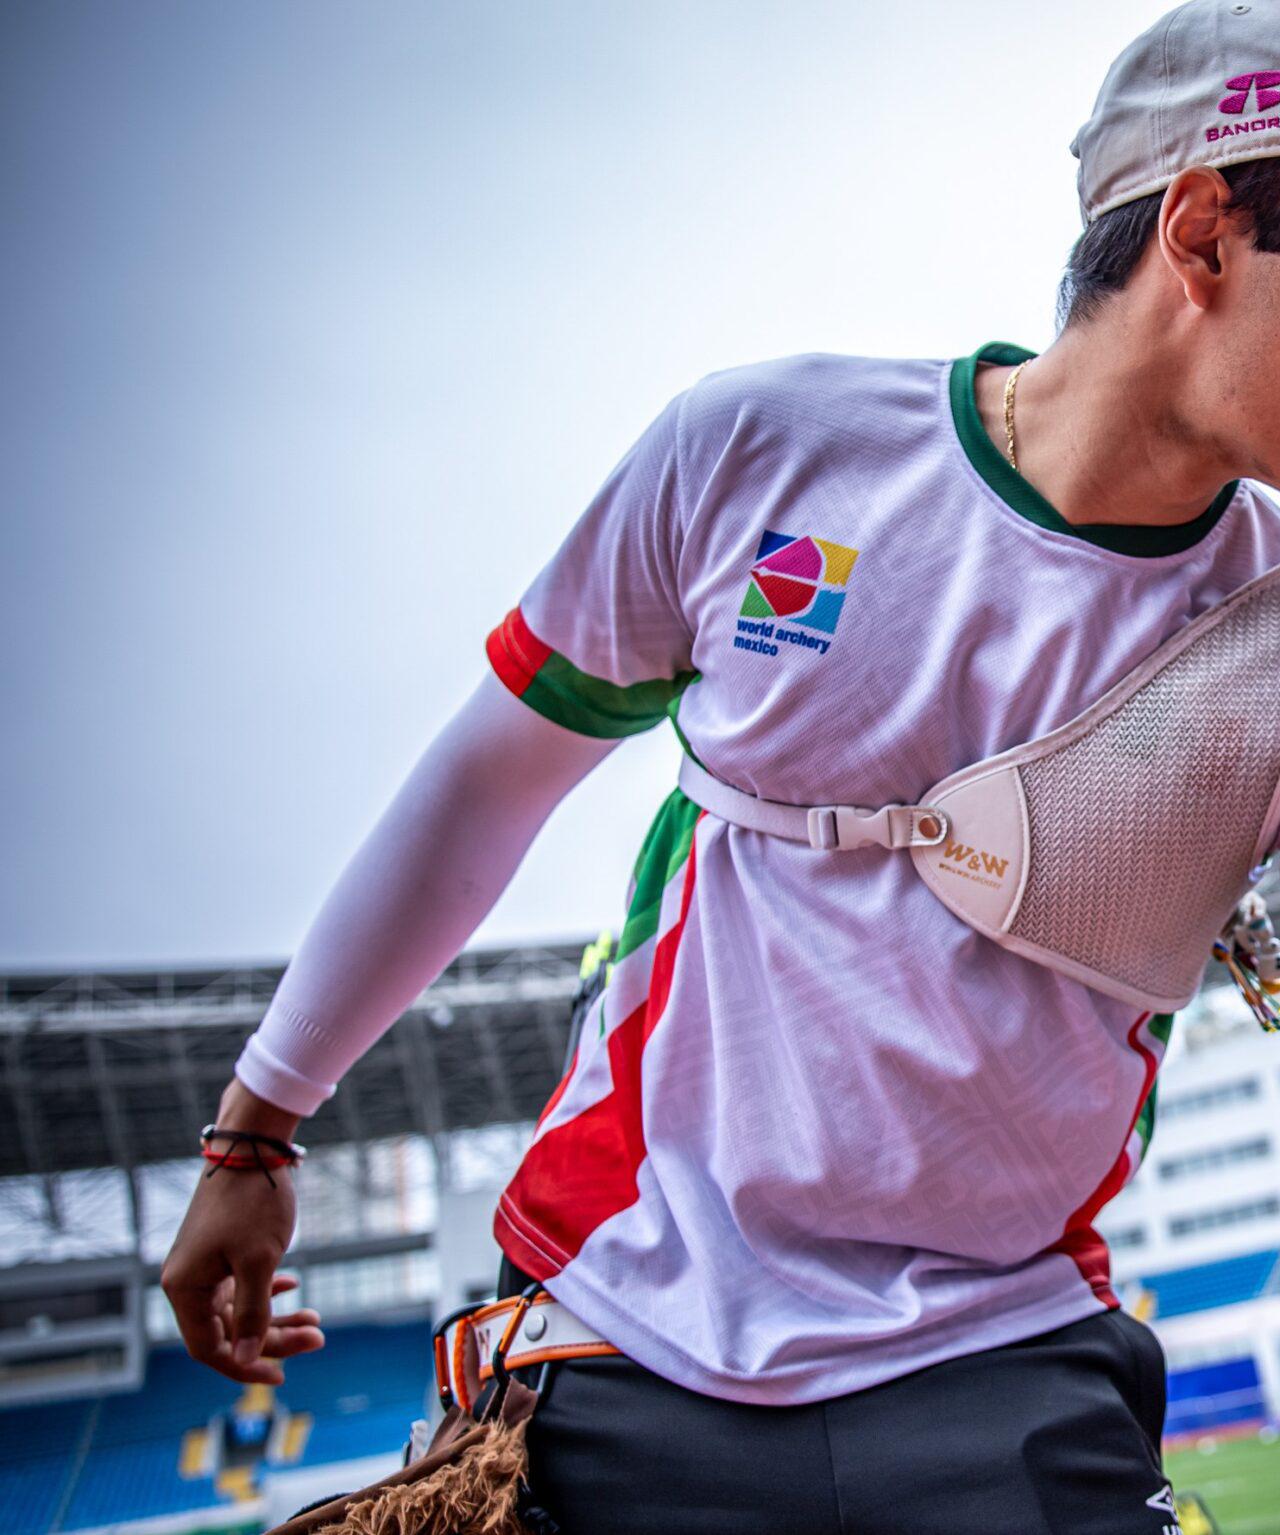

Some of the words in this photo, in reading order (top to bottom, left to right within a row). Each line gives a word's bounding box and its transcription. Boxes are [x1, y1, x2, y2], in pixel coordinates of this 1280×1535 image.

[734, 636, 779, 656] mexico
[737, 619, 775, 637] world
[775, 627, 831, 654] archery
